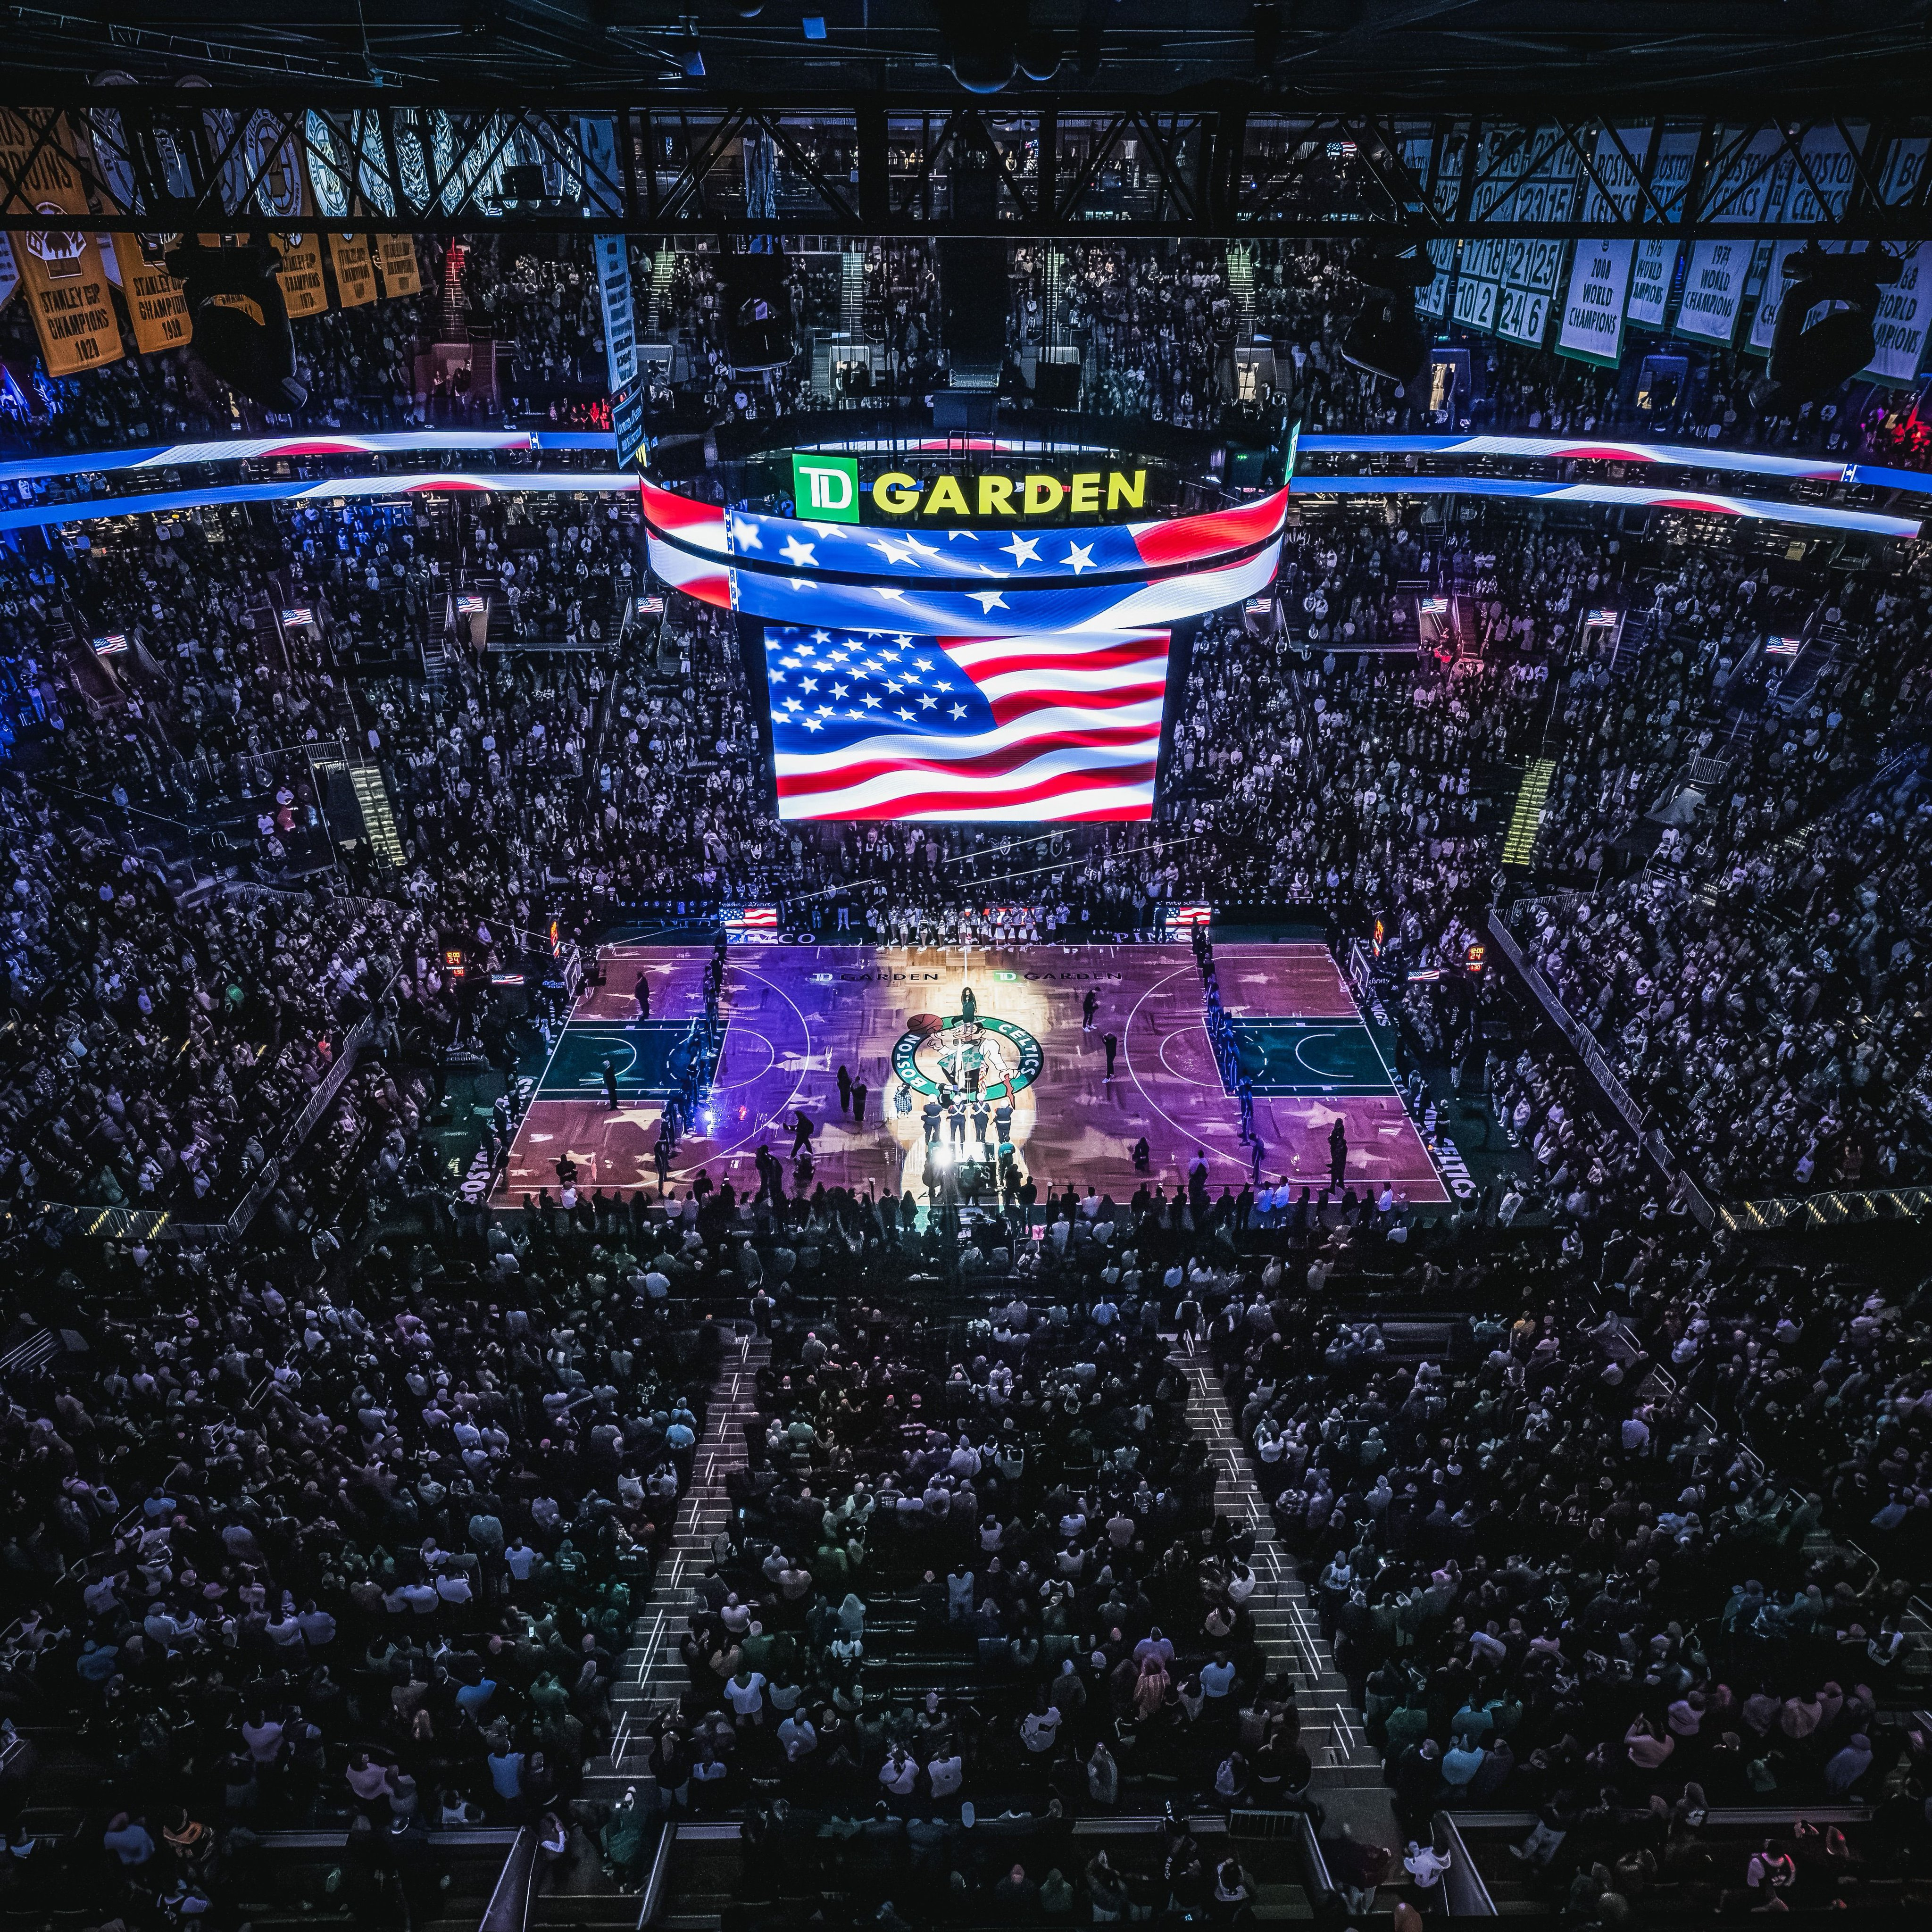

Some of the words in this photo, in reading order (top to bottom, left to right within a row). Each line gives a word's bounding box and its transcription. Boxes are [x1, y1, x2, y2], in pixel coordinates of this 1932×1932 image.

[1520, 187, 1543, 221] 23
[1465, 239, 1482, 272] 17
[1486, 239, 1501, 275] 18
[1512, 242, 1532, 283] 21
[1532, 244, 1554, 285] 25
[1583, 283, 1613, 307] WORLD
[1700, 269, 1731, 291] WORLD
[1459, 282, 1474, 318] 10
[1480, 289, 1491, 323] 2
[1501, 292, 1523, 333] 24
[1529, 299, 1541, 337] 6
[1684, 291, 1735, 317] CHAMPIONS
[48, 308, 109, 340] CHAMPIONS
[1569, 307, 1617, 335] CHAMPIONS
[799, 466, 853, 510] TD
[873, 470, 1146, 515] GARDEN
[812, 973, 833, 981] TD
[996, 972, 1016, 981] TD
[1024, 972, 1122, 980] GARDEN
[896, 1034, 928, 1088] BOSTON
[998, 1024, 1039, 1075] CELTICS
